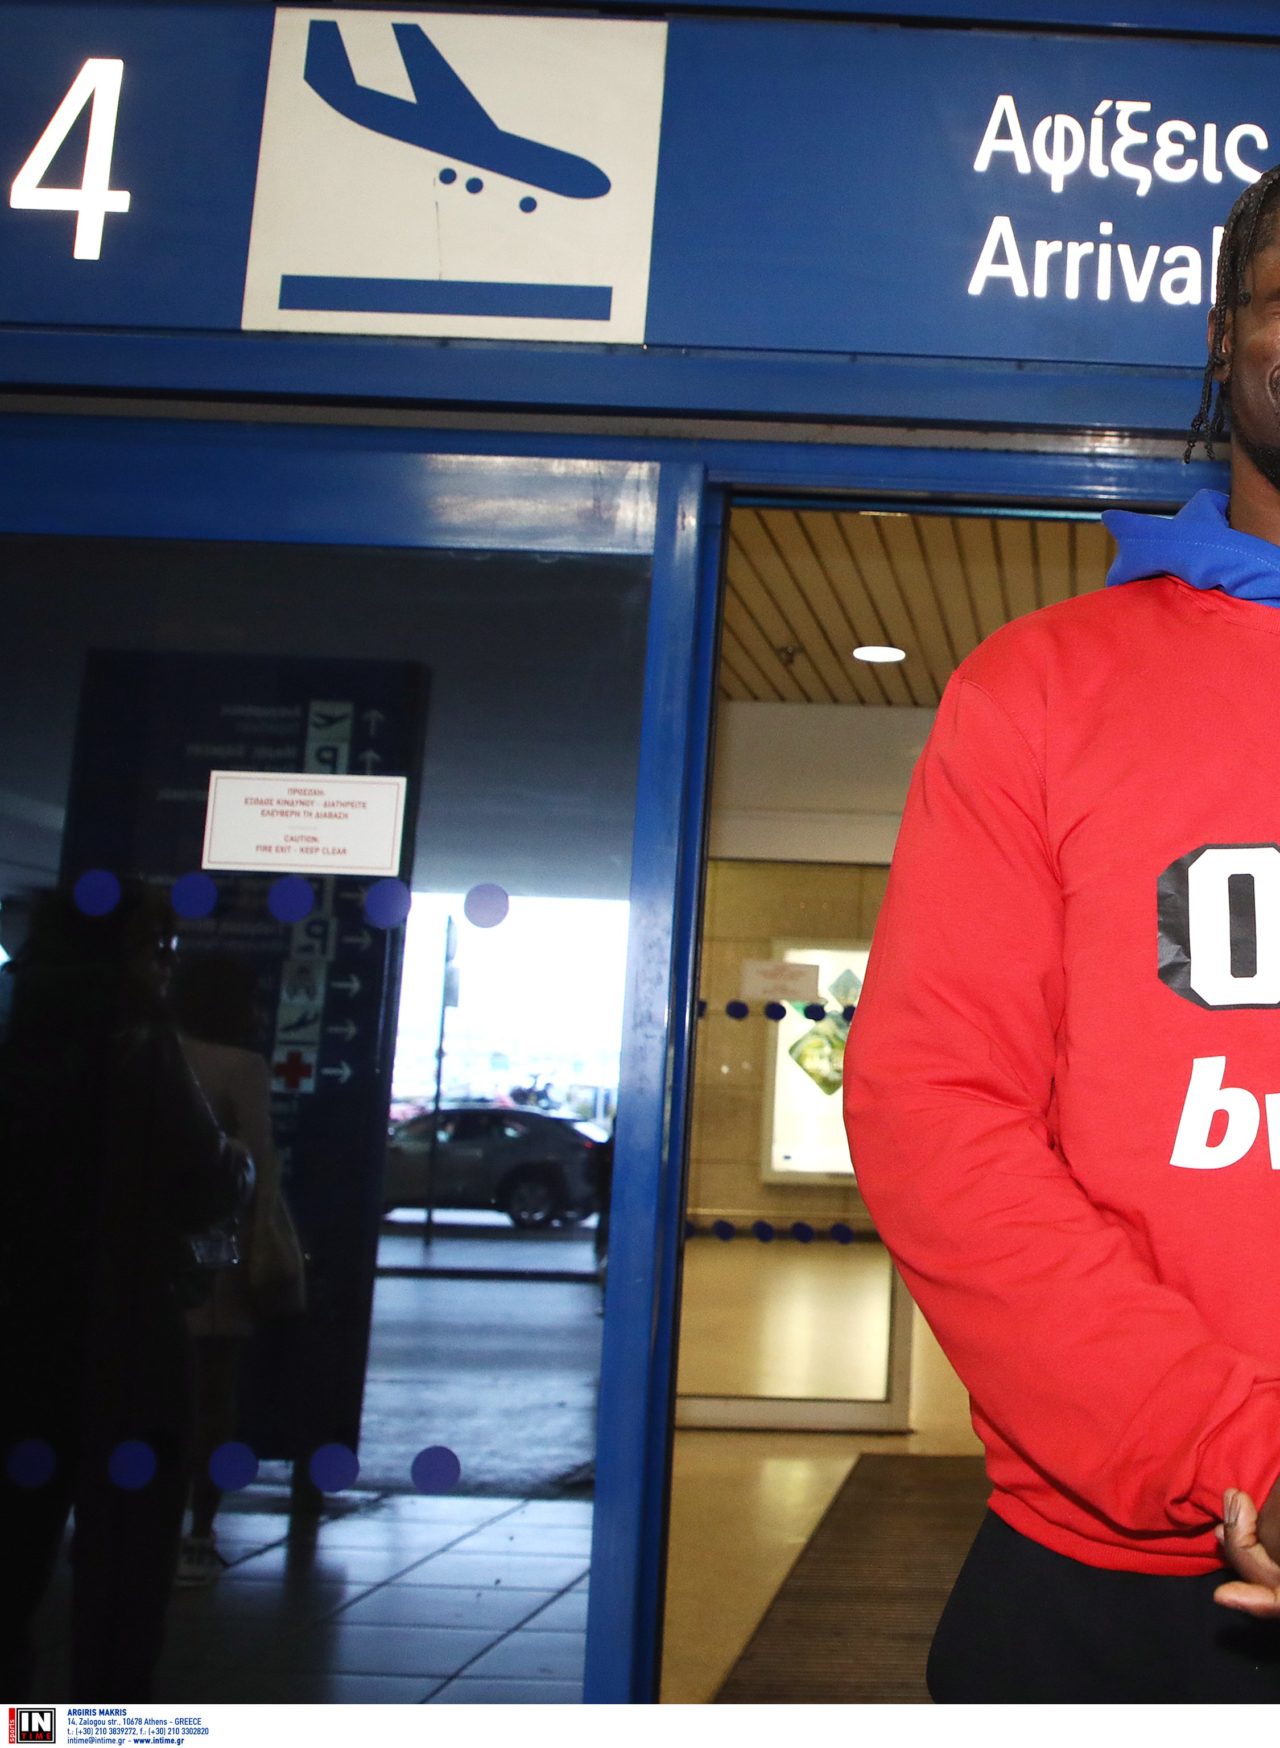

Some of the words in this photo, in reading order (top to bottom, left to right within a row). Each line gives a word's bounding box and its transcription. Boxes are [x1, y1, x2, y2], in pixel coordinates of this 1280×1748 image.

[9, 57, 131, 261] 4
[972, 94, 1270, 197] Αφίξεις
[967, 215, 1225, 306] Arrival
